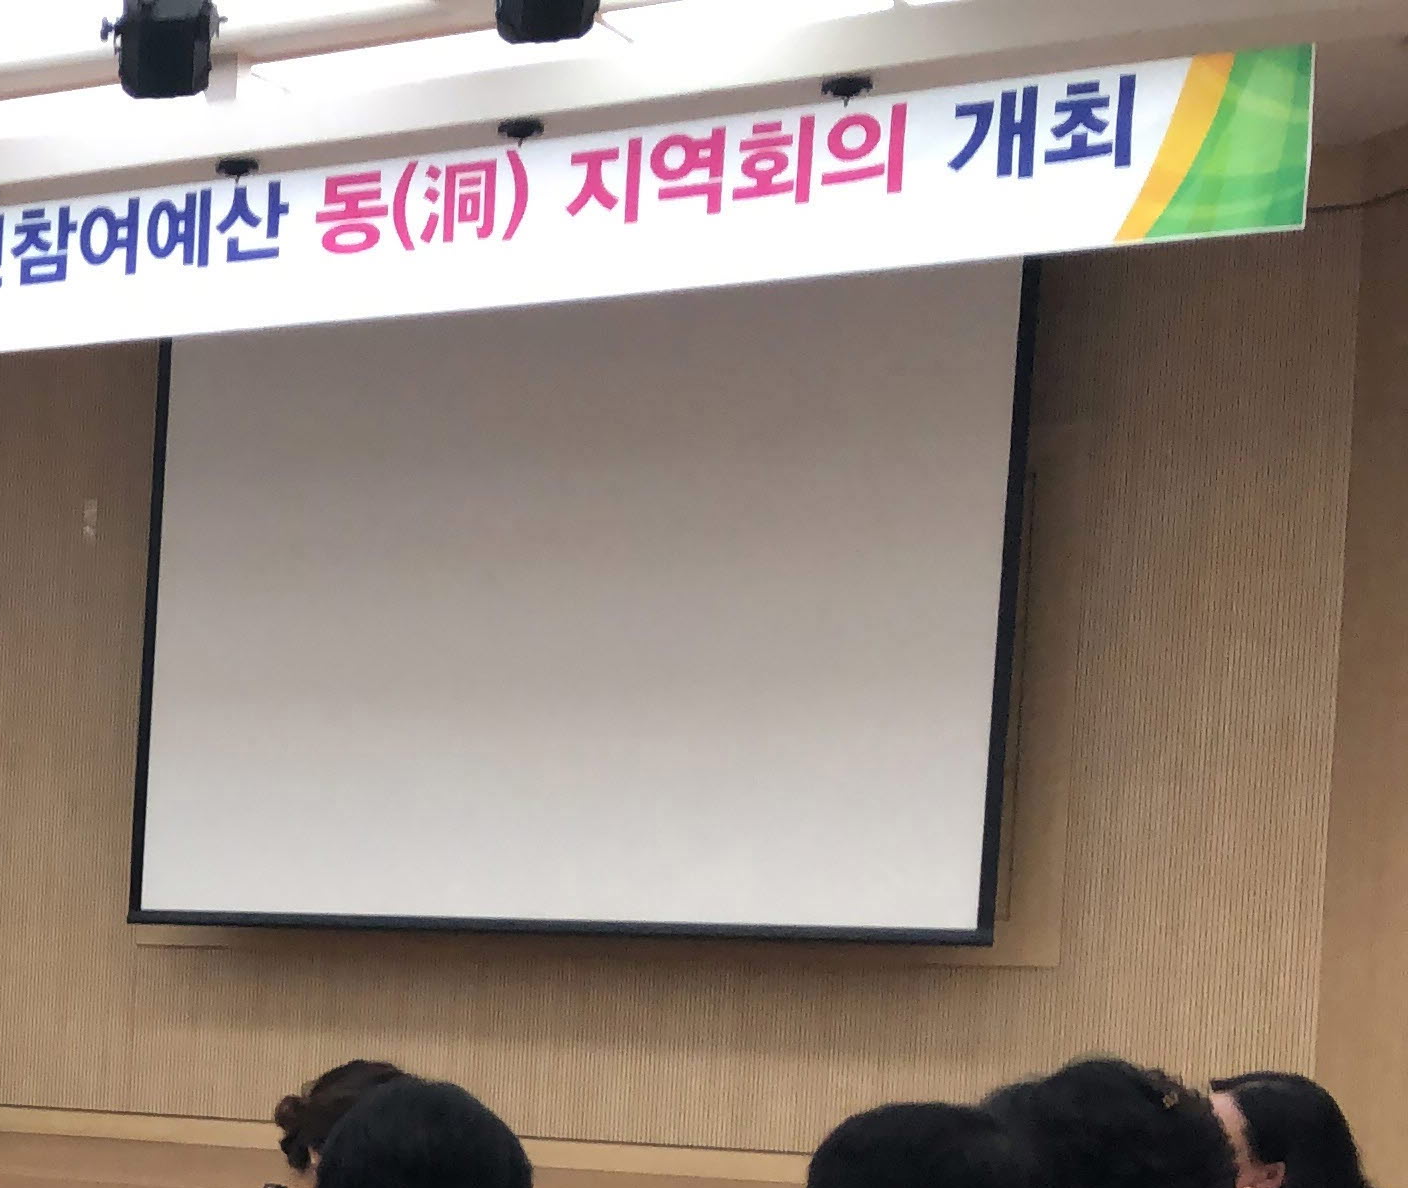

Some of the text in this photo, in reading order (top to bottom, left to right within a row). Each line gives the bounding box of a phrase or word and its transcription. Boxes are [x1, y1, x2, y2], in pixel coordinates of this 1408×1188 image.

[315, 149, 529, 254] 동(洞)
[566, 102, 907, 224] 지역회의
[947, 73, 1137, 181] 개최
